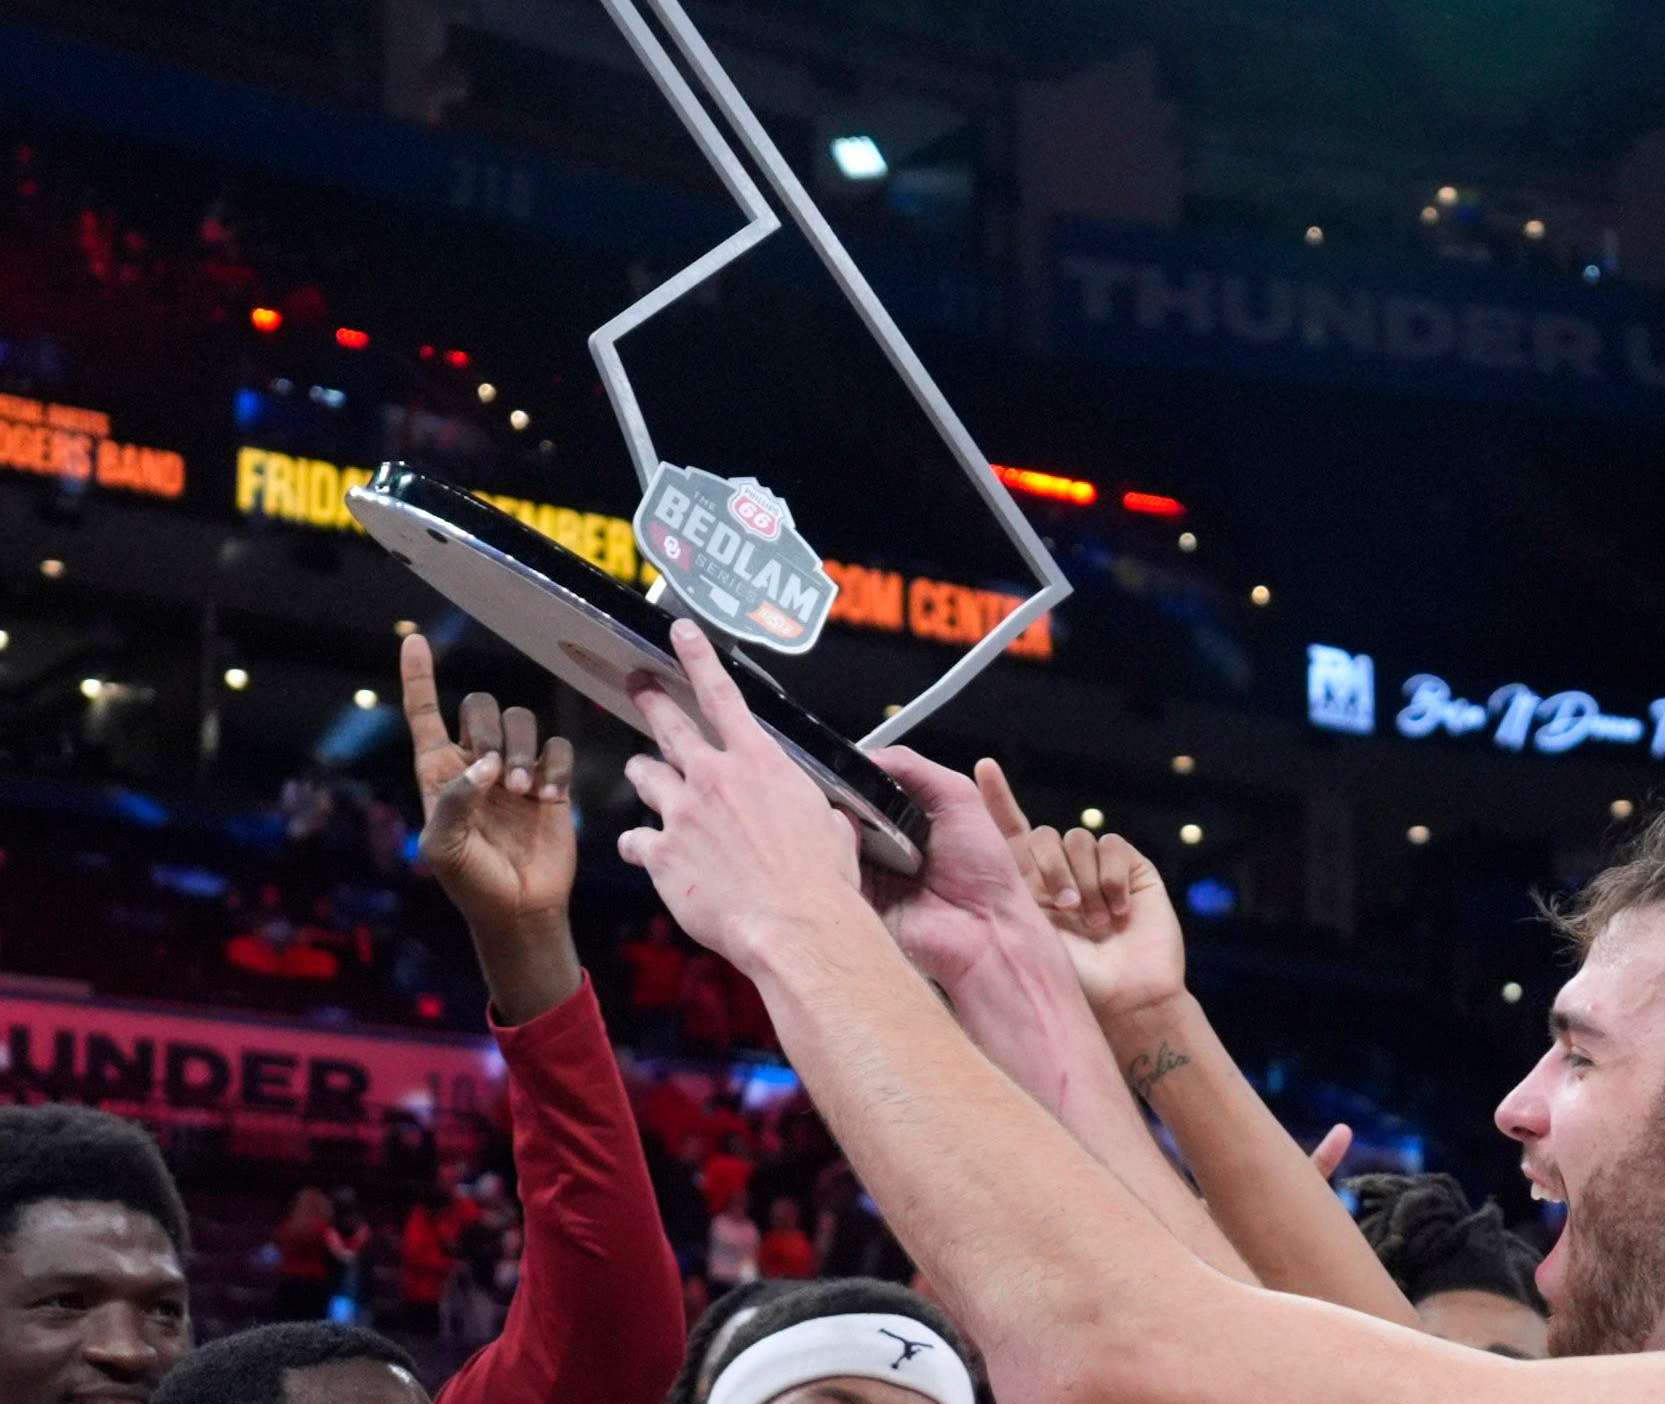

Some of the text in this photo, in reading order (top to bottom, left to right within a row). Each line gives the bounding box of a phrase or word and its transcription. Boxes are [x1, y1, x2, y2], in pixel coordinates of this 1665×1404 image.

[1063, 256, 1602, 378] THUNDER
[96, 438, 185, 498] BAND
[693, 490, 717, 512] THE
[738, 502, 773, 529] 66
[654, 484, 821, 624] BEDLAM
